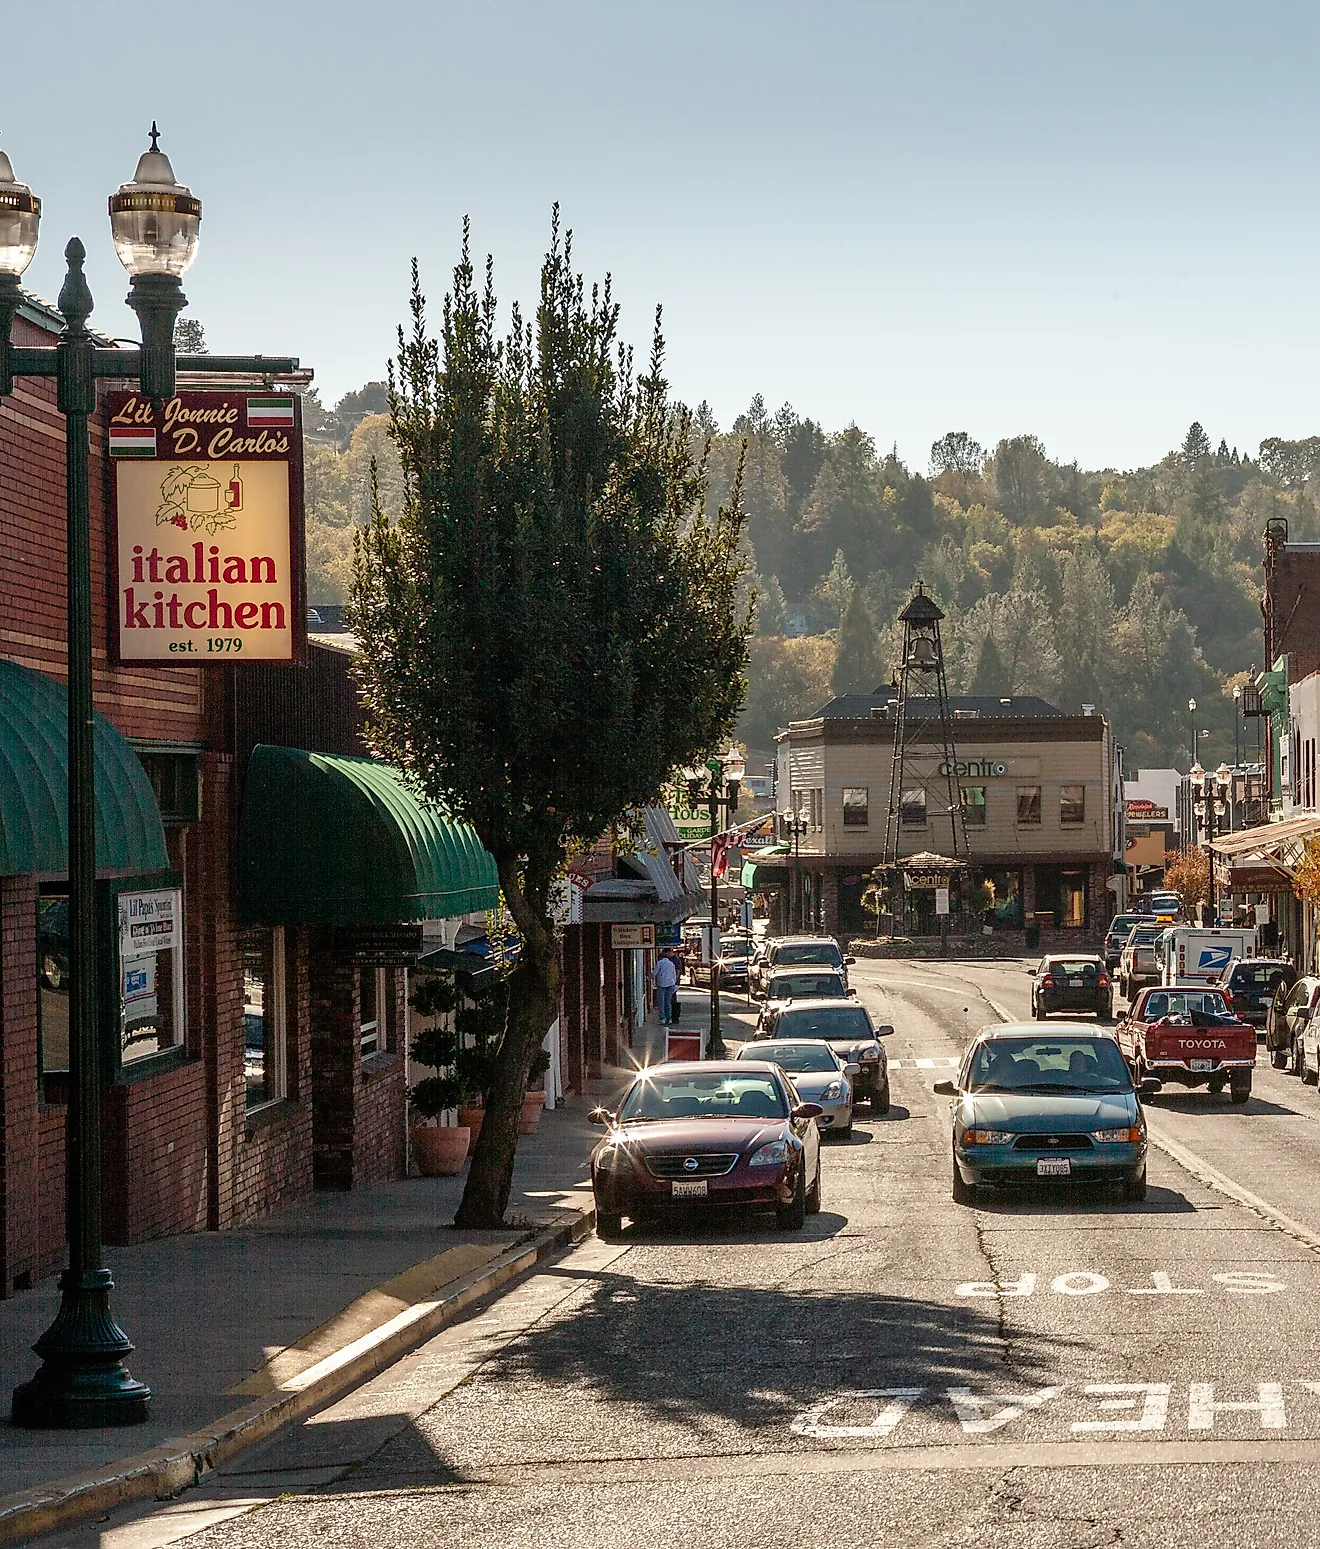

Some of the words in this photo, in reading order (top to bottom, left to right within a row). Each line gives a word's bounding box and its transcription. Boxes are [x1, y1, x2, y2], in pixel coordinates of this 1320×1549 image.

[162, 397, 238, 433] Jonnie
[173, 428, 201, 453] D.
[208, 428, 290, 458] Carlo's
[131, 541, 277, 584] italian
[123, 587, 287, 629] kitchen
[168, 640, 198, 652] est.
[206, 637, 243, 652] 1979
[939, 758, 1008, 777] centro
[670, 808, 712, 821] HOUS
[911, 873, 949, 885] centro
[1178, 1039, 1226, 1049] TOYOTA
[955, 1271, 1287, 1297] STOP
